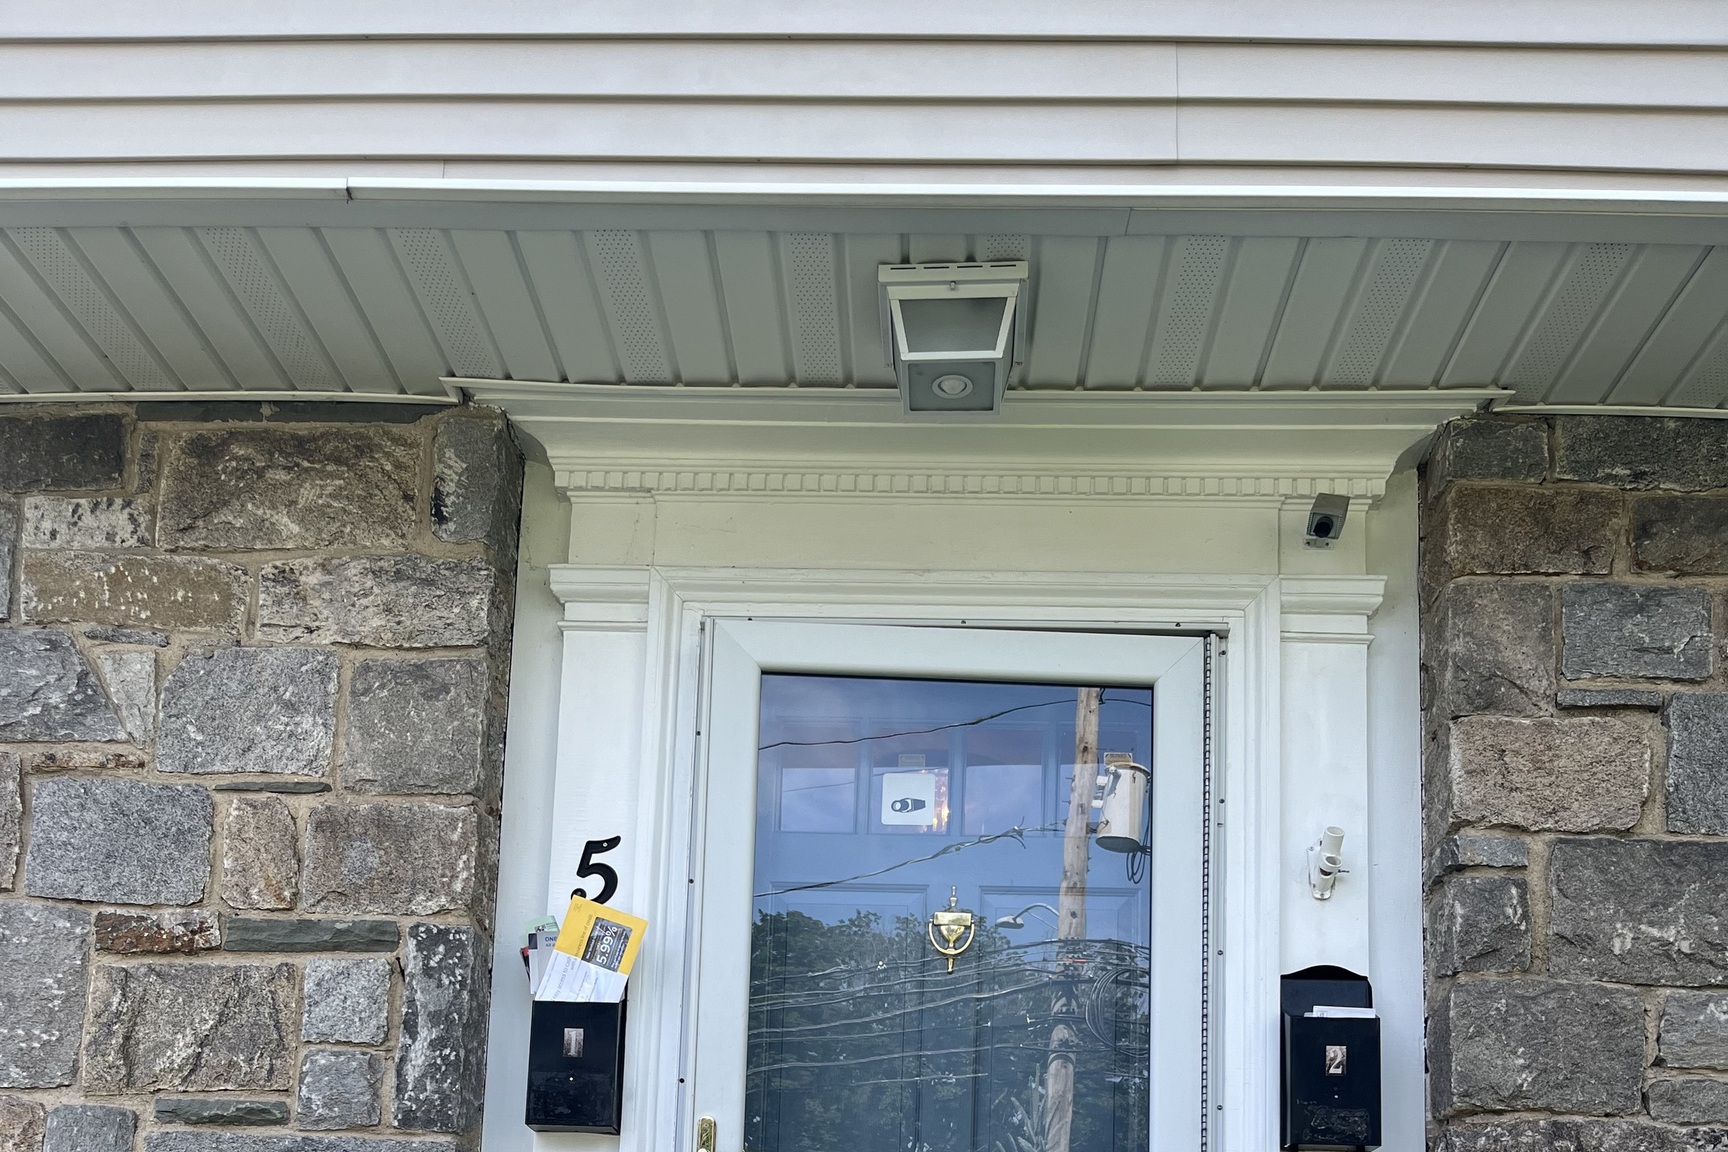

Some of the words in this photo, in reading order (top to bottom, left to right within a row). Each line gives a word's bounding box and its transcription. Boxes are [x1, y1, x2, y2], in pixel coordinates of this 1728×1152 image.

[571, 835, 621, 905] 5
[596, 926, 617, 964] 5.99%
[558, 974, 566, 989] access
[567, 1030, 578, 1056] 1
[1329, 1048, 1343, 1074] 2
